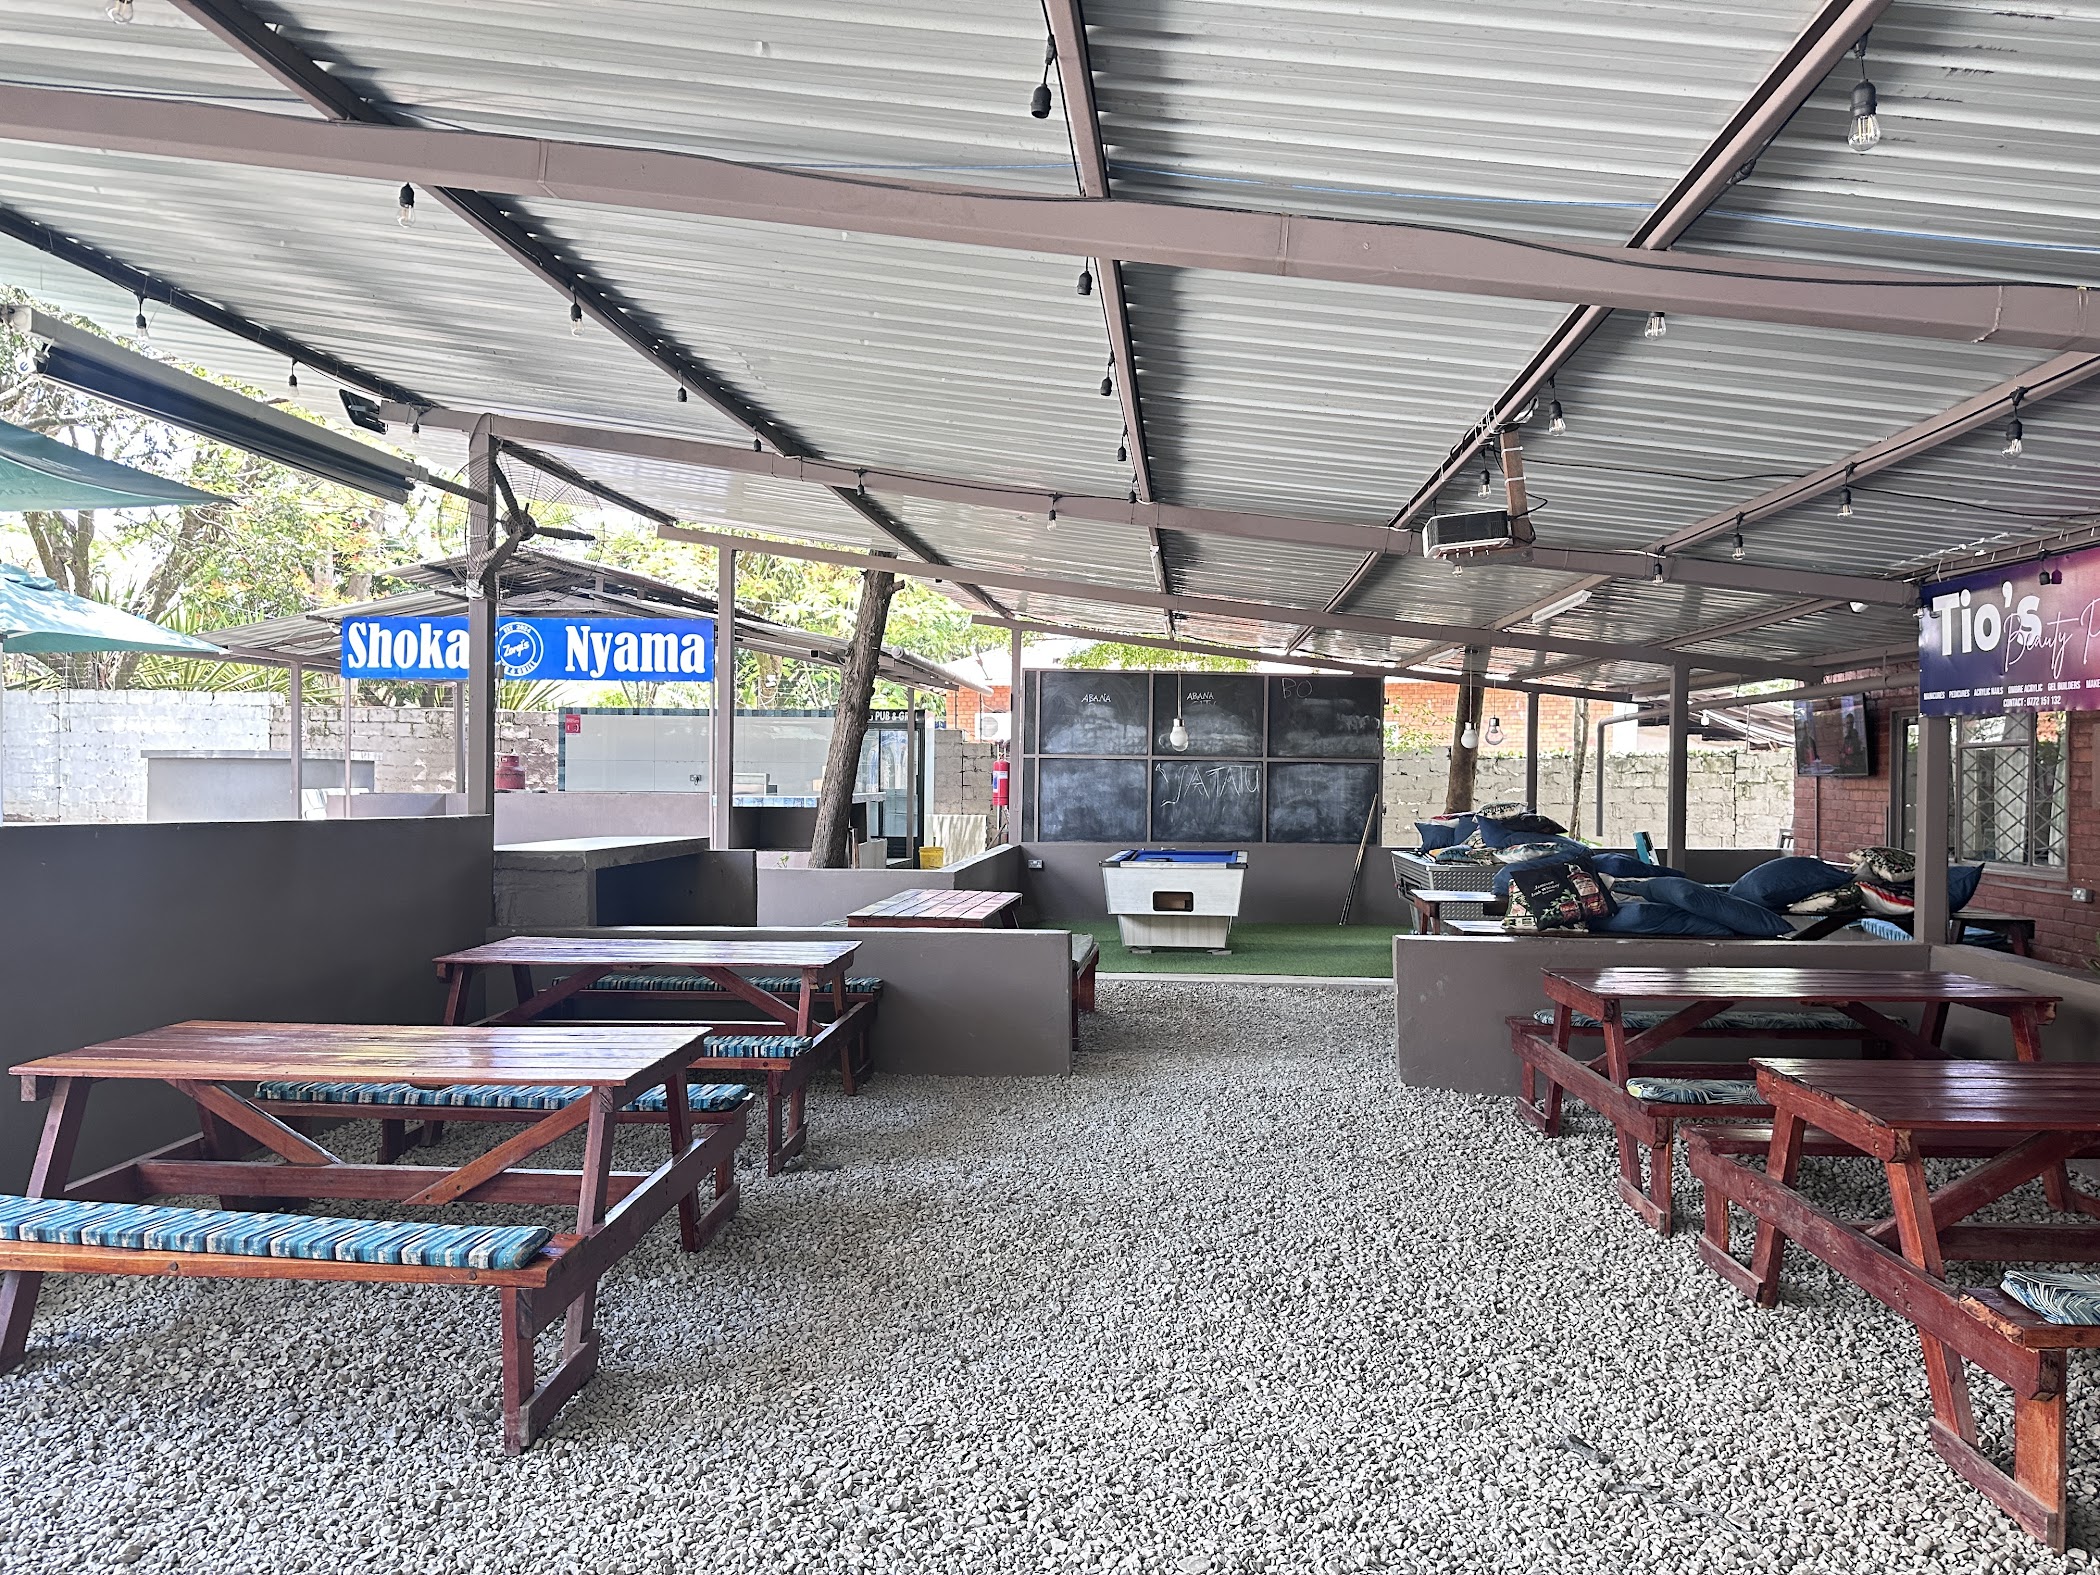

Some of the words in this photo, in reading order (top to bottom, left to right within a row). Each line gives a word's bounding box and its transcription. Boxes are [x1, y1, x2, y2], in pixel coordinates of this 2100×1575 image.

[1932, 581, 2042, 656] Tio's
[347, 622, 470, 669] Shoka
[564, 625, 706, 678] Nyama
[2003, 612, 2079, 679] Beauty
[2047, 682, 2057, 692] GEL
[1081, 693, 1112, 703] ABANA
[1186, 691, 1215, 701] ABANA
[2026, 696, 2040, 706] 0772
[2040, 696, 2050, 706] 151
[2051, 695, 2061, 705] 132
[875, 711, 891, 721] PUB
